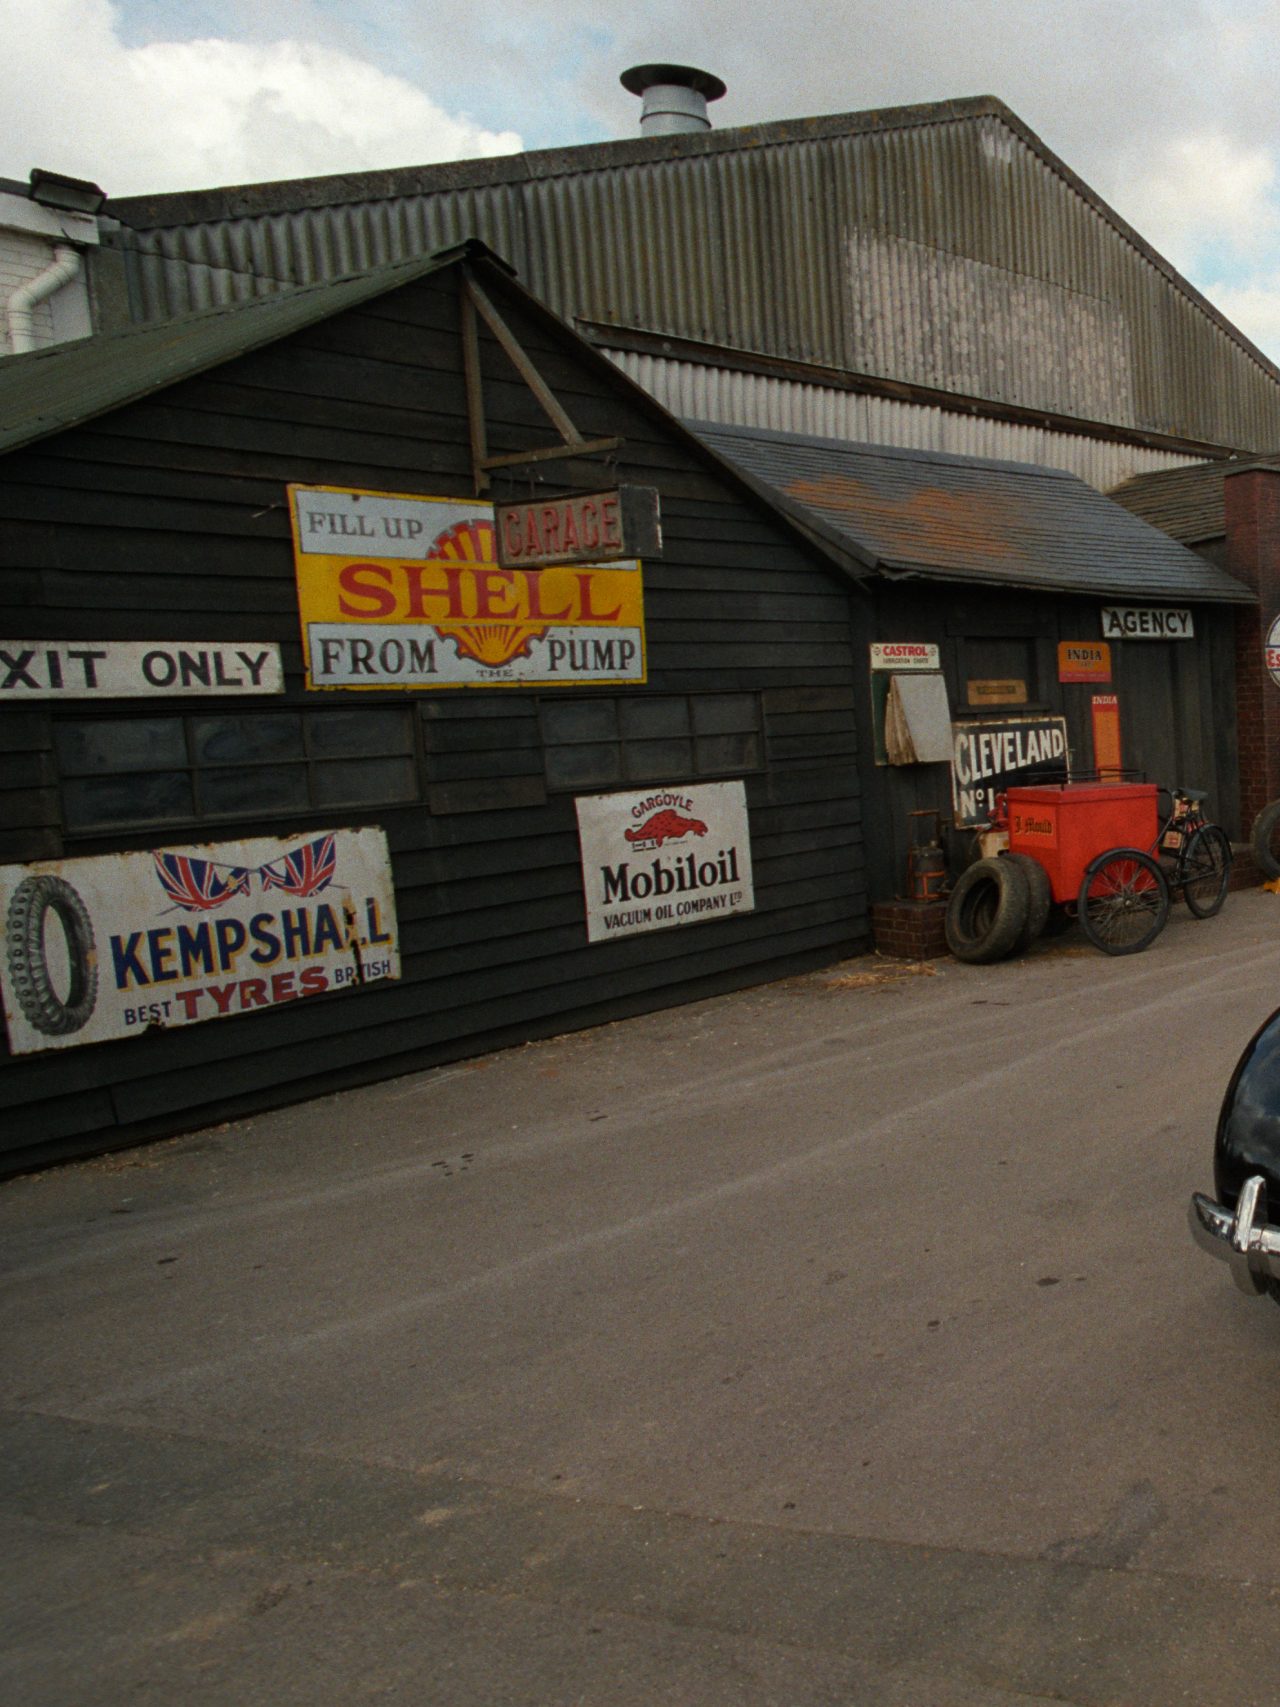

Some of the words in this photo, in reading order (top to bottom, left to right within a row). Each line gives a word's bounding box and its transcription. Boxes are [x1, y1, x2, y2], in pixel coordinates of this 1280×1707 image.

[307, 510, 375, 538] FILL
[384, 516, 424, 540] UP
[504, 499, 622, 558] GARAGE
[338, 562, 623, 622] SHELL
[1108, 610, 1189, 633] AGENCY
[142, 650, 269, 687] ONLY
[318, 637, 438, 675] FROM
[547, 638, 636, 672] PUMP
[882, 645, 928, 657] CASTROL
[1067, 649, 1102, 661] INDIA
[476, 668, 515, 678] THE
[1092, 695, 1118, 705] INDIA
[955, 728, 1064, 786] CLEVELAND
[631, 793, 694, 819] GARGOYLE
[601, 846, 740, 905] Mobiloil
[603, 907, 652, 930] VACUUM
[655, 904, 674, 920] OIL
[676, 893, 727, 915] COMPANY
[123, 1000, 173, 1026] BEST
[175, 965, 329, 1020] TYRES
